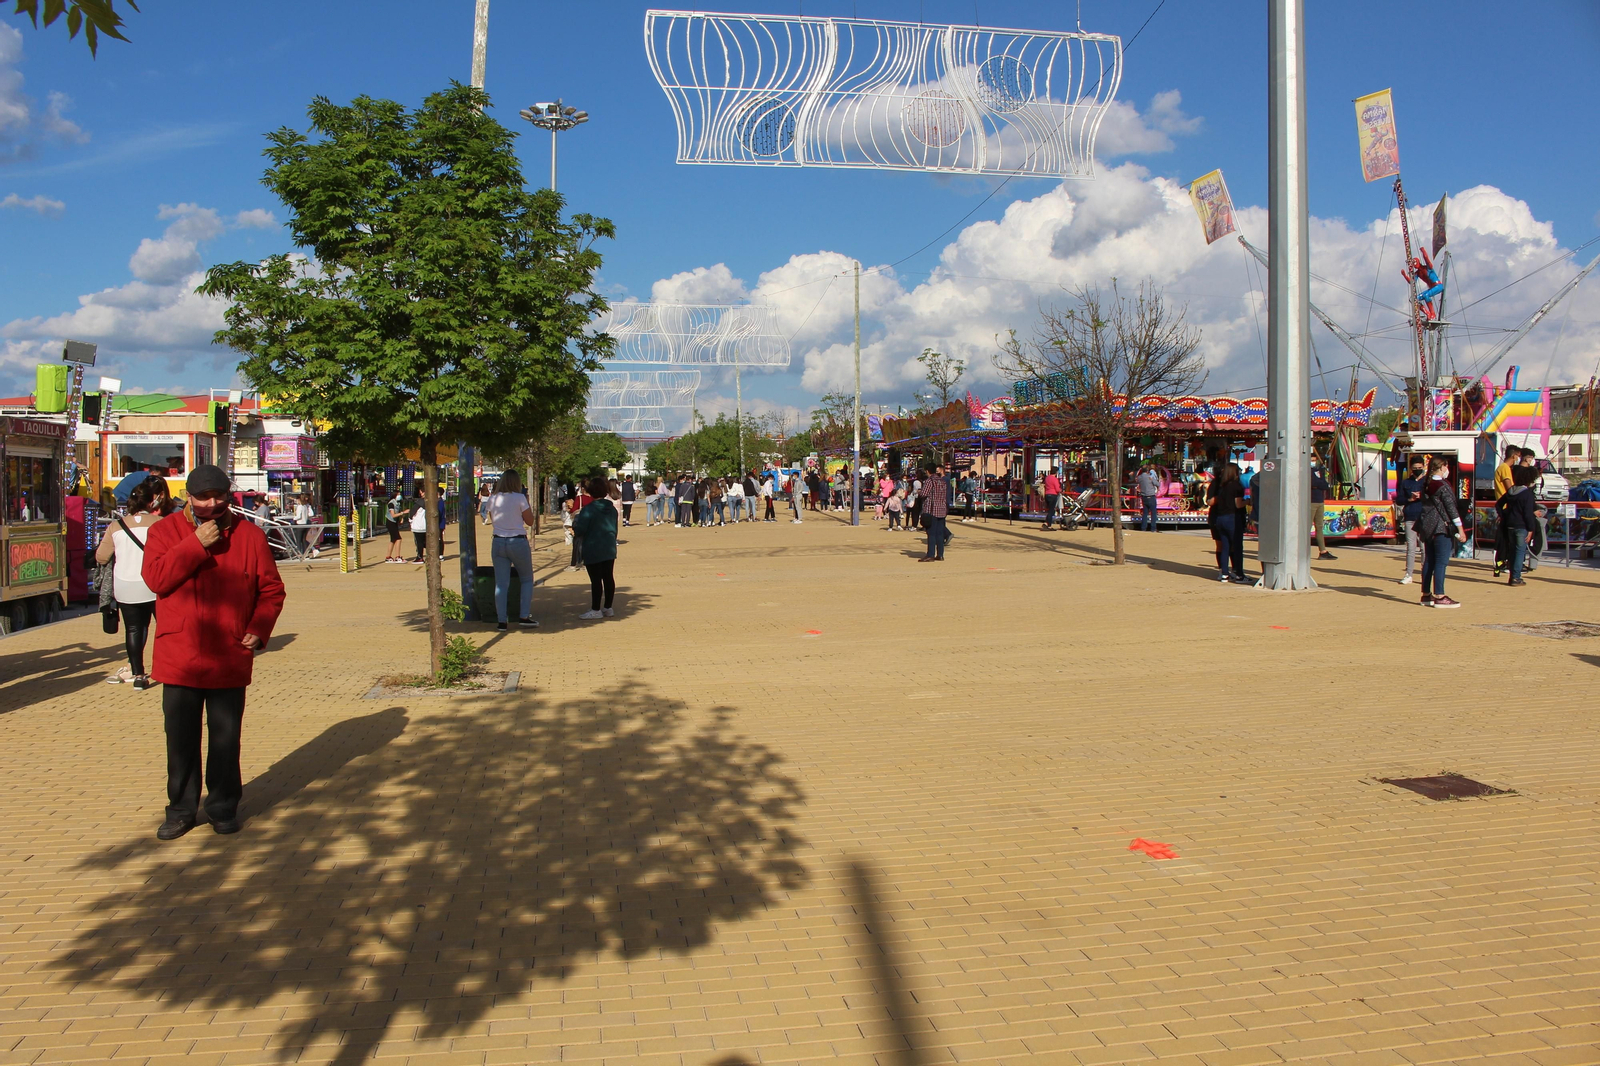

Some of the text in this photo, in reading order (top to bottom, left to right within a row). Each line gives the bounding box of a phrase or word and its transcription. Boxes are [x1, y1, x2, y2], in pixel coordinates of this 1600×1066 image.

[22, 421, 60, 436] TAQUILLA
[10, 541, 54, 568] RANITA
[19, 560, 49, 580] FELIZ
